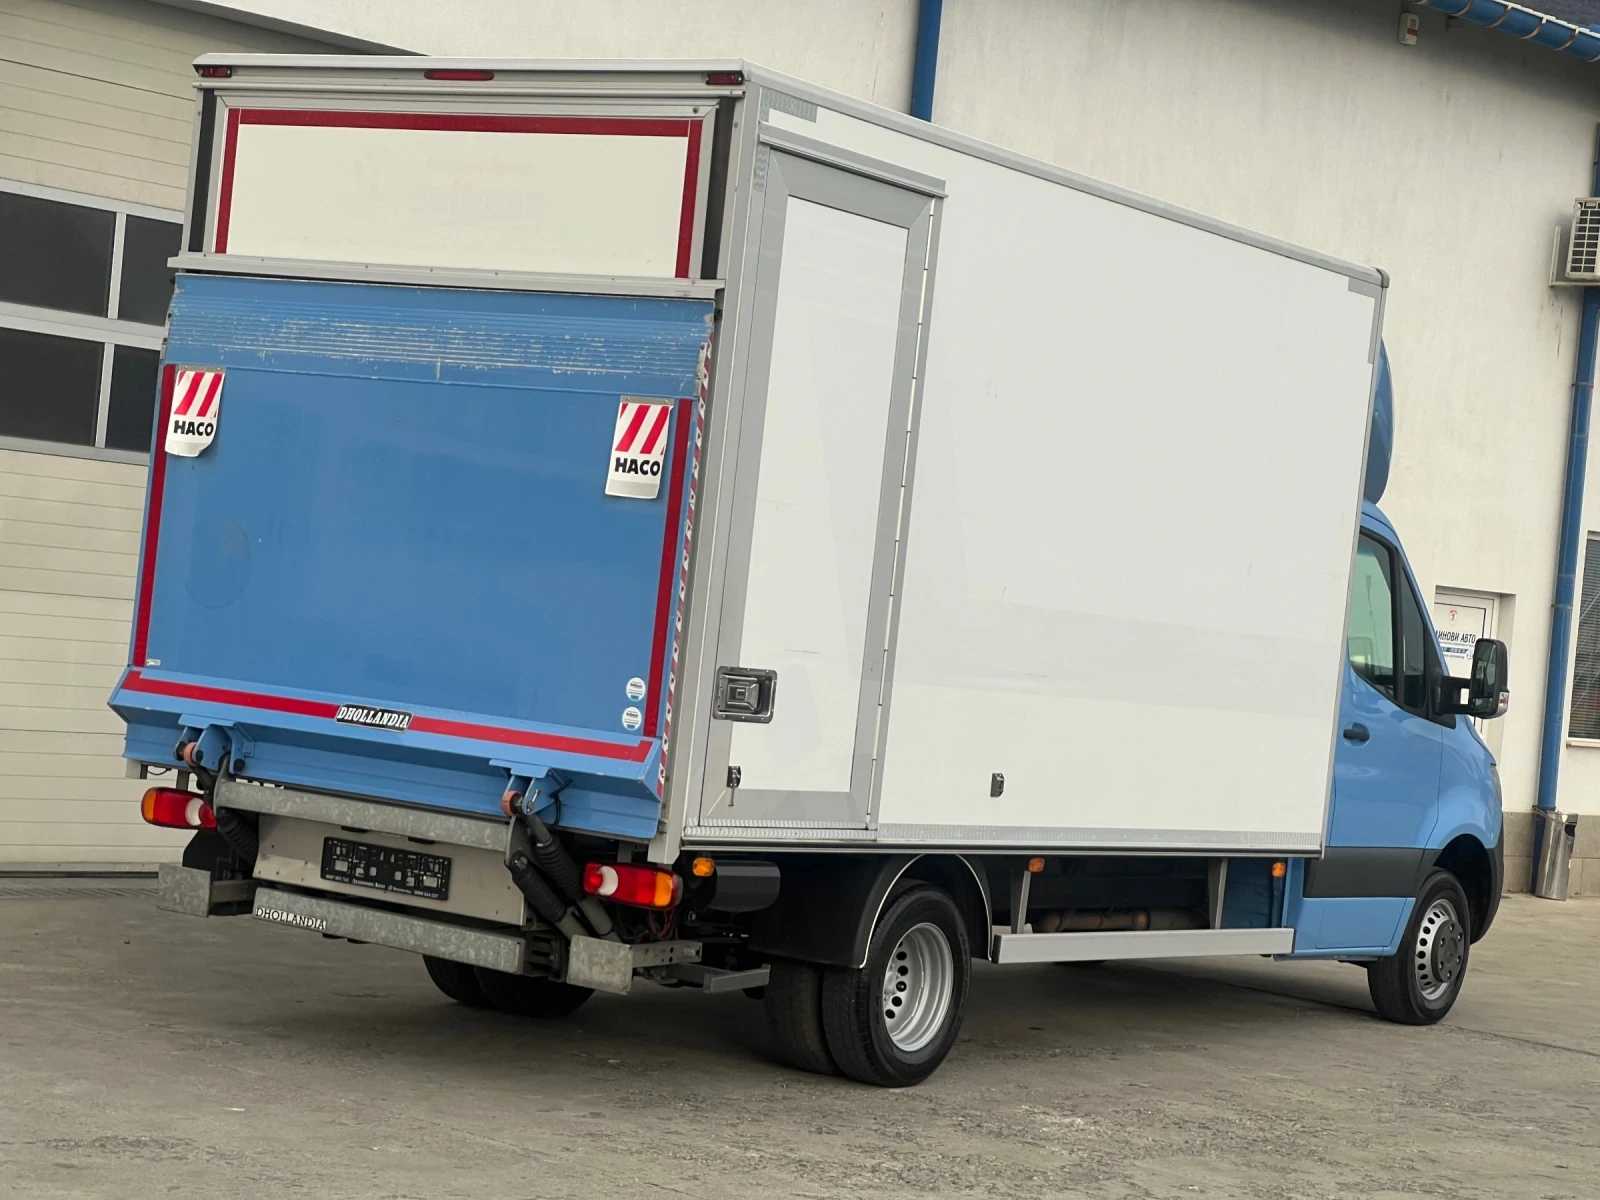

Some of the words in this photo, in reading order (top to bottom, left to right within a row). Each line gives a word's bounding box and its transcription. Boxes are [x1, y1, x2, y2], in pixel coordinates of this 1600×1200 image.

[173, 419, 214, 436] HACO
[614, 457, 661, 476] HACO
[1460, 633, 1476, 644] АВТО
[337, 706, 409, 728] DHOLLANDIA
[256, 906, 327, 930] DHOLLANDIA
